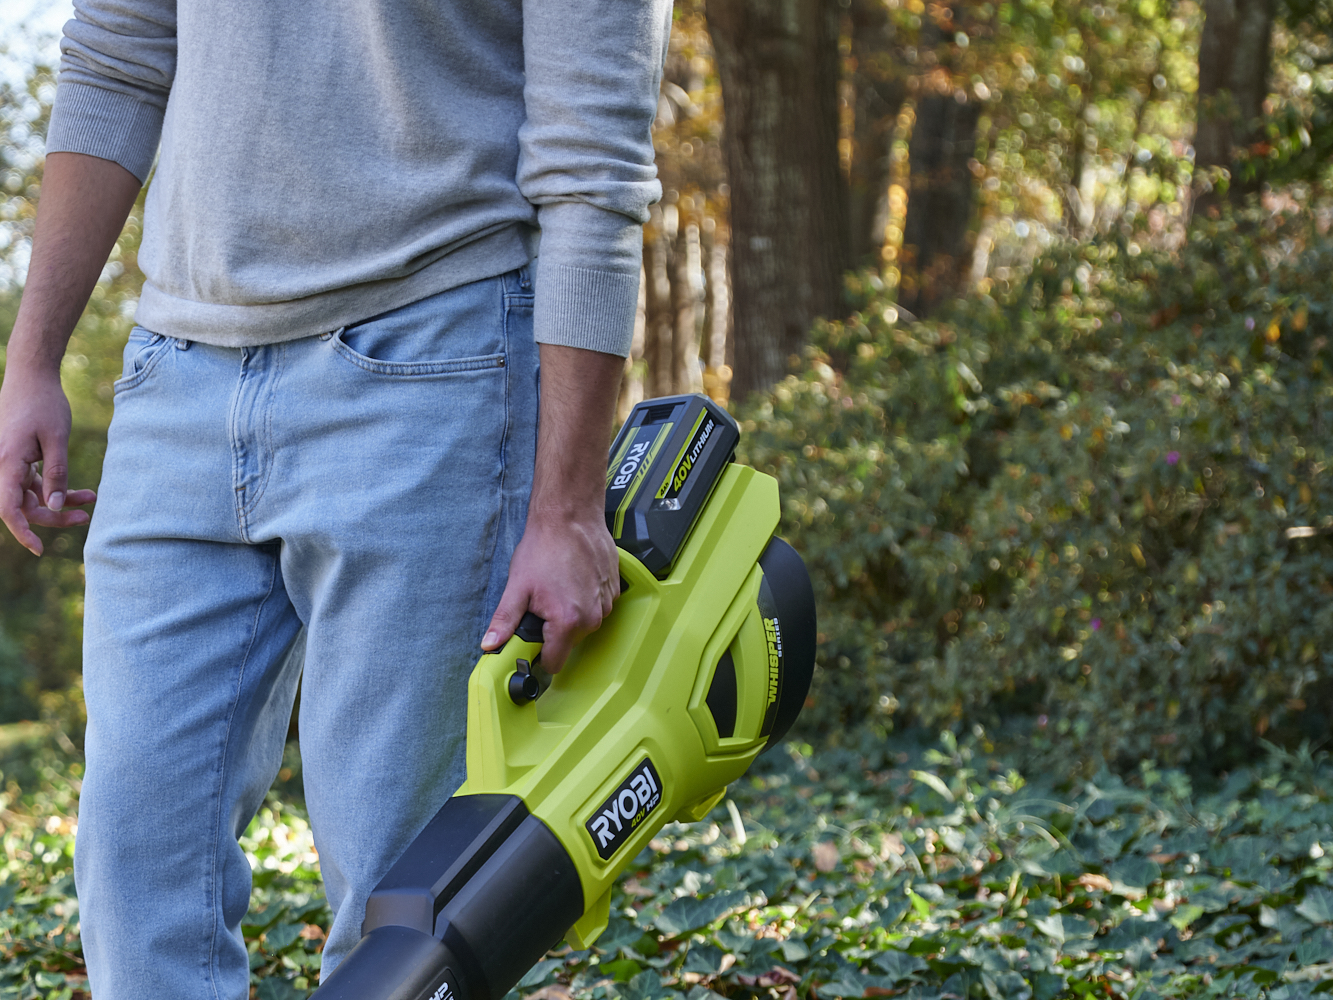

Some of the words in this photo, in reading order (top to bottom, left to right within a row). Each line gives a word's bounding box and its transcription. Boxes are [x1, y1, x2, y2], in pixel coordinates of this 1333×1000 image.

[611, 441, 650, 490] RYOBI
[764, 617, 778, 708] WHISPER
[591, 766, 658, 849] RYOBI
[631, 807, 645, 828] 40V
[646, 793, 659, 812] HP
